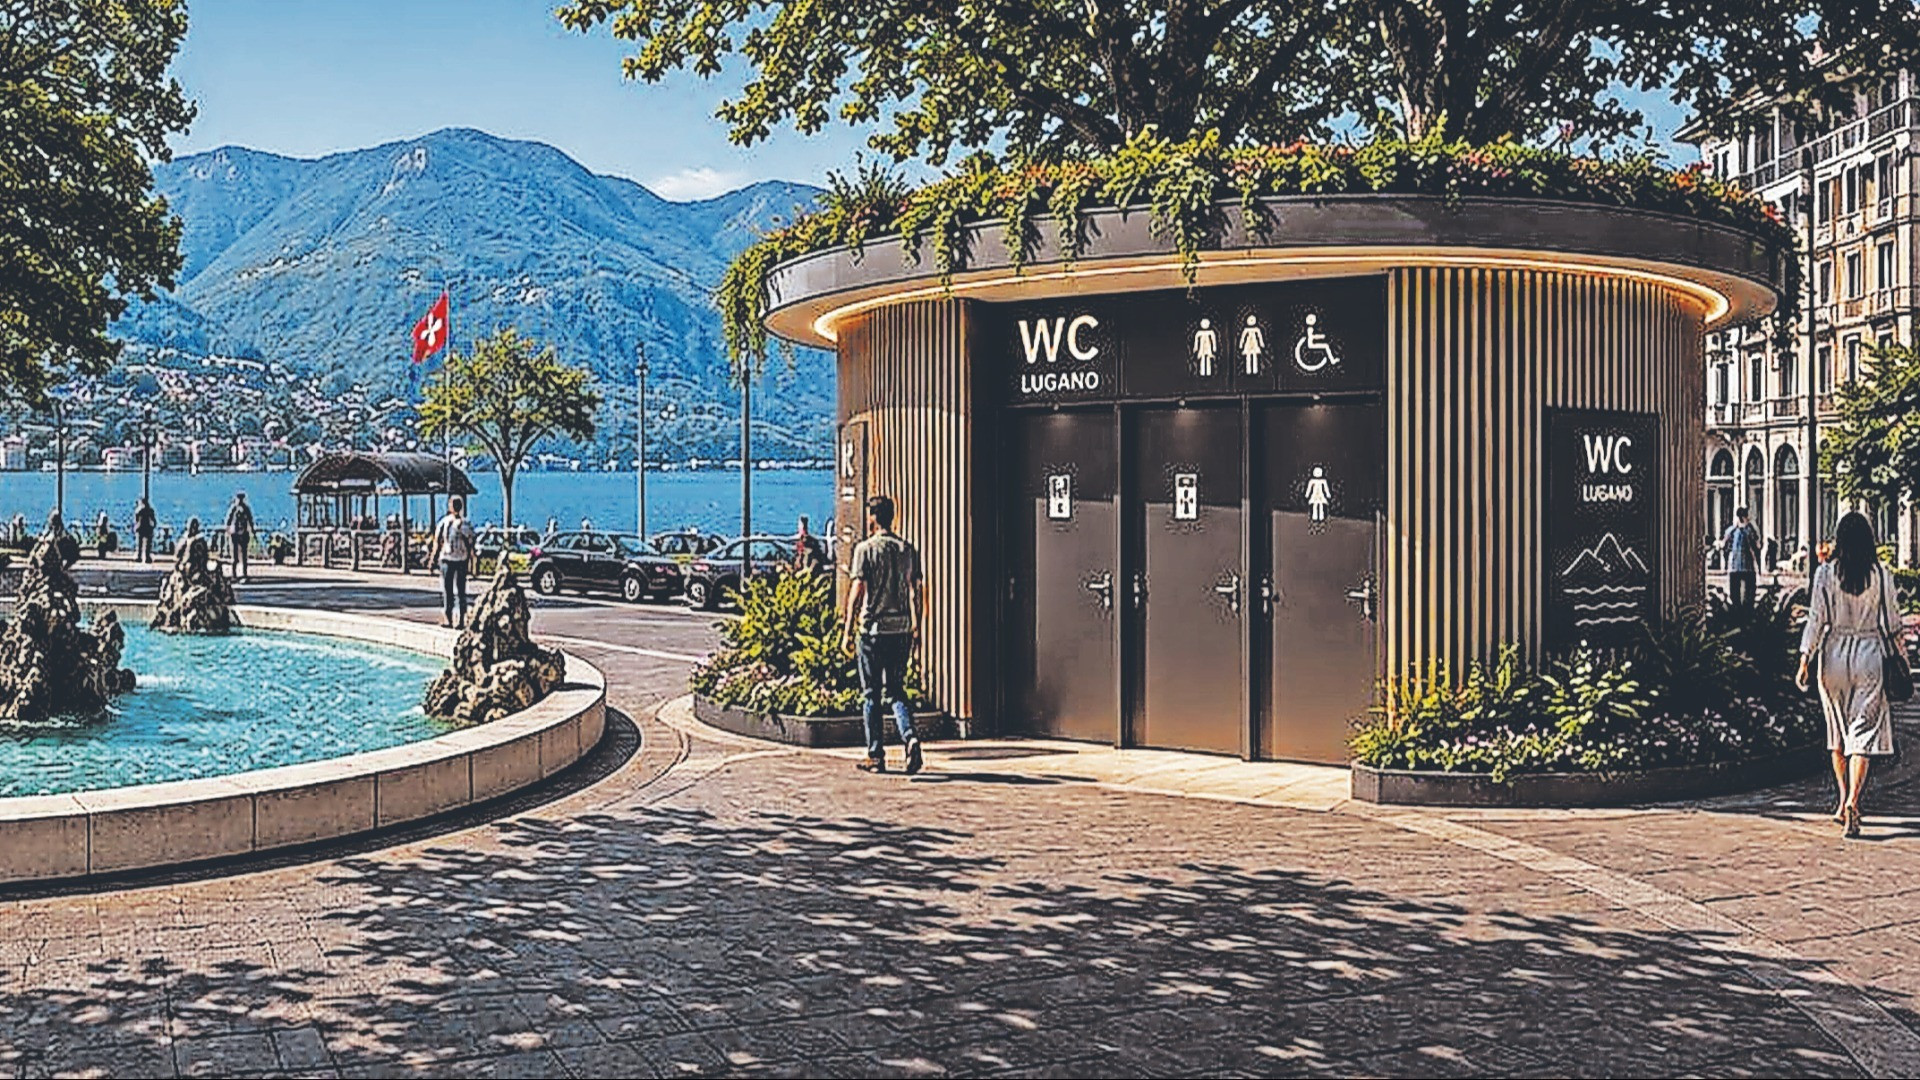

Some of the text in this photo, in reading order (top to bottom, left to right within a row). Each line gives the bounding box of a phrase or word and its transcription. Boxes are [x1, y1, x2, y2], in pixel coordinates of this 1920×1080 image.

[1018, 314, 1099, 364] WC
[1021, 371, 1099, 393] LUGANO
[1583, 434, 1632, 474] WC
